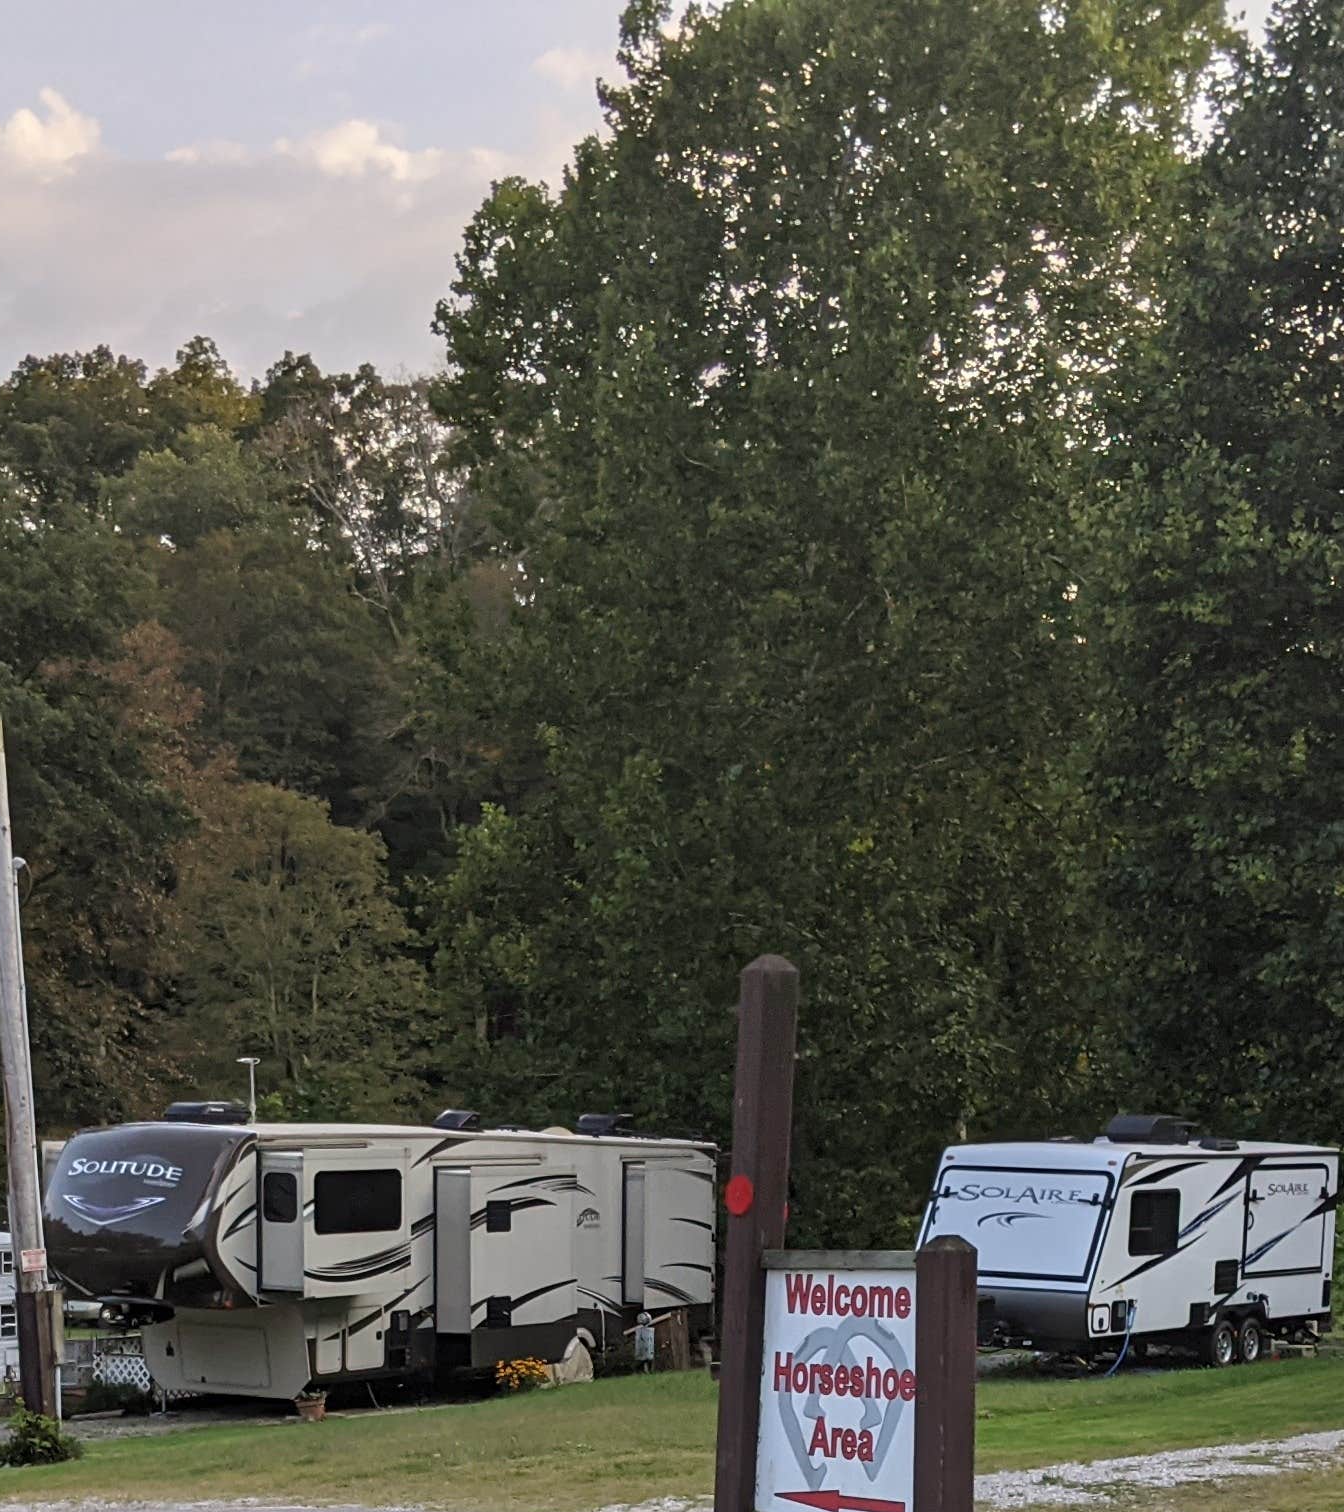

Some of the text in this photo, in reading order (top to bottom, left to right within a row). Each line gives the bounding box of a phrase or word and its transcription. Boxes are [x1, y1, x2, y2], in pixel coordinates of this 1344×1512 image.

[67, 1158, 183, 1181] SOLITUDE
[957, 1184, 1082, 1205] SOLAIRE
[785, 1273, 911, 1319] Welcome
[773, 1351, 917, 1401] Horseshoe
[808, 1415, 873, 1461] Area
